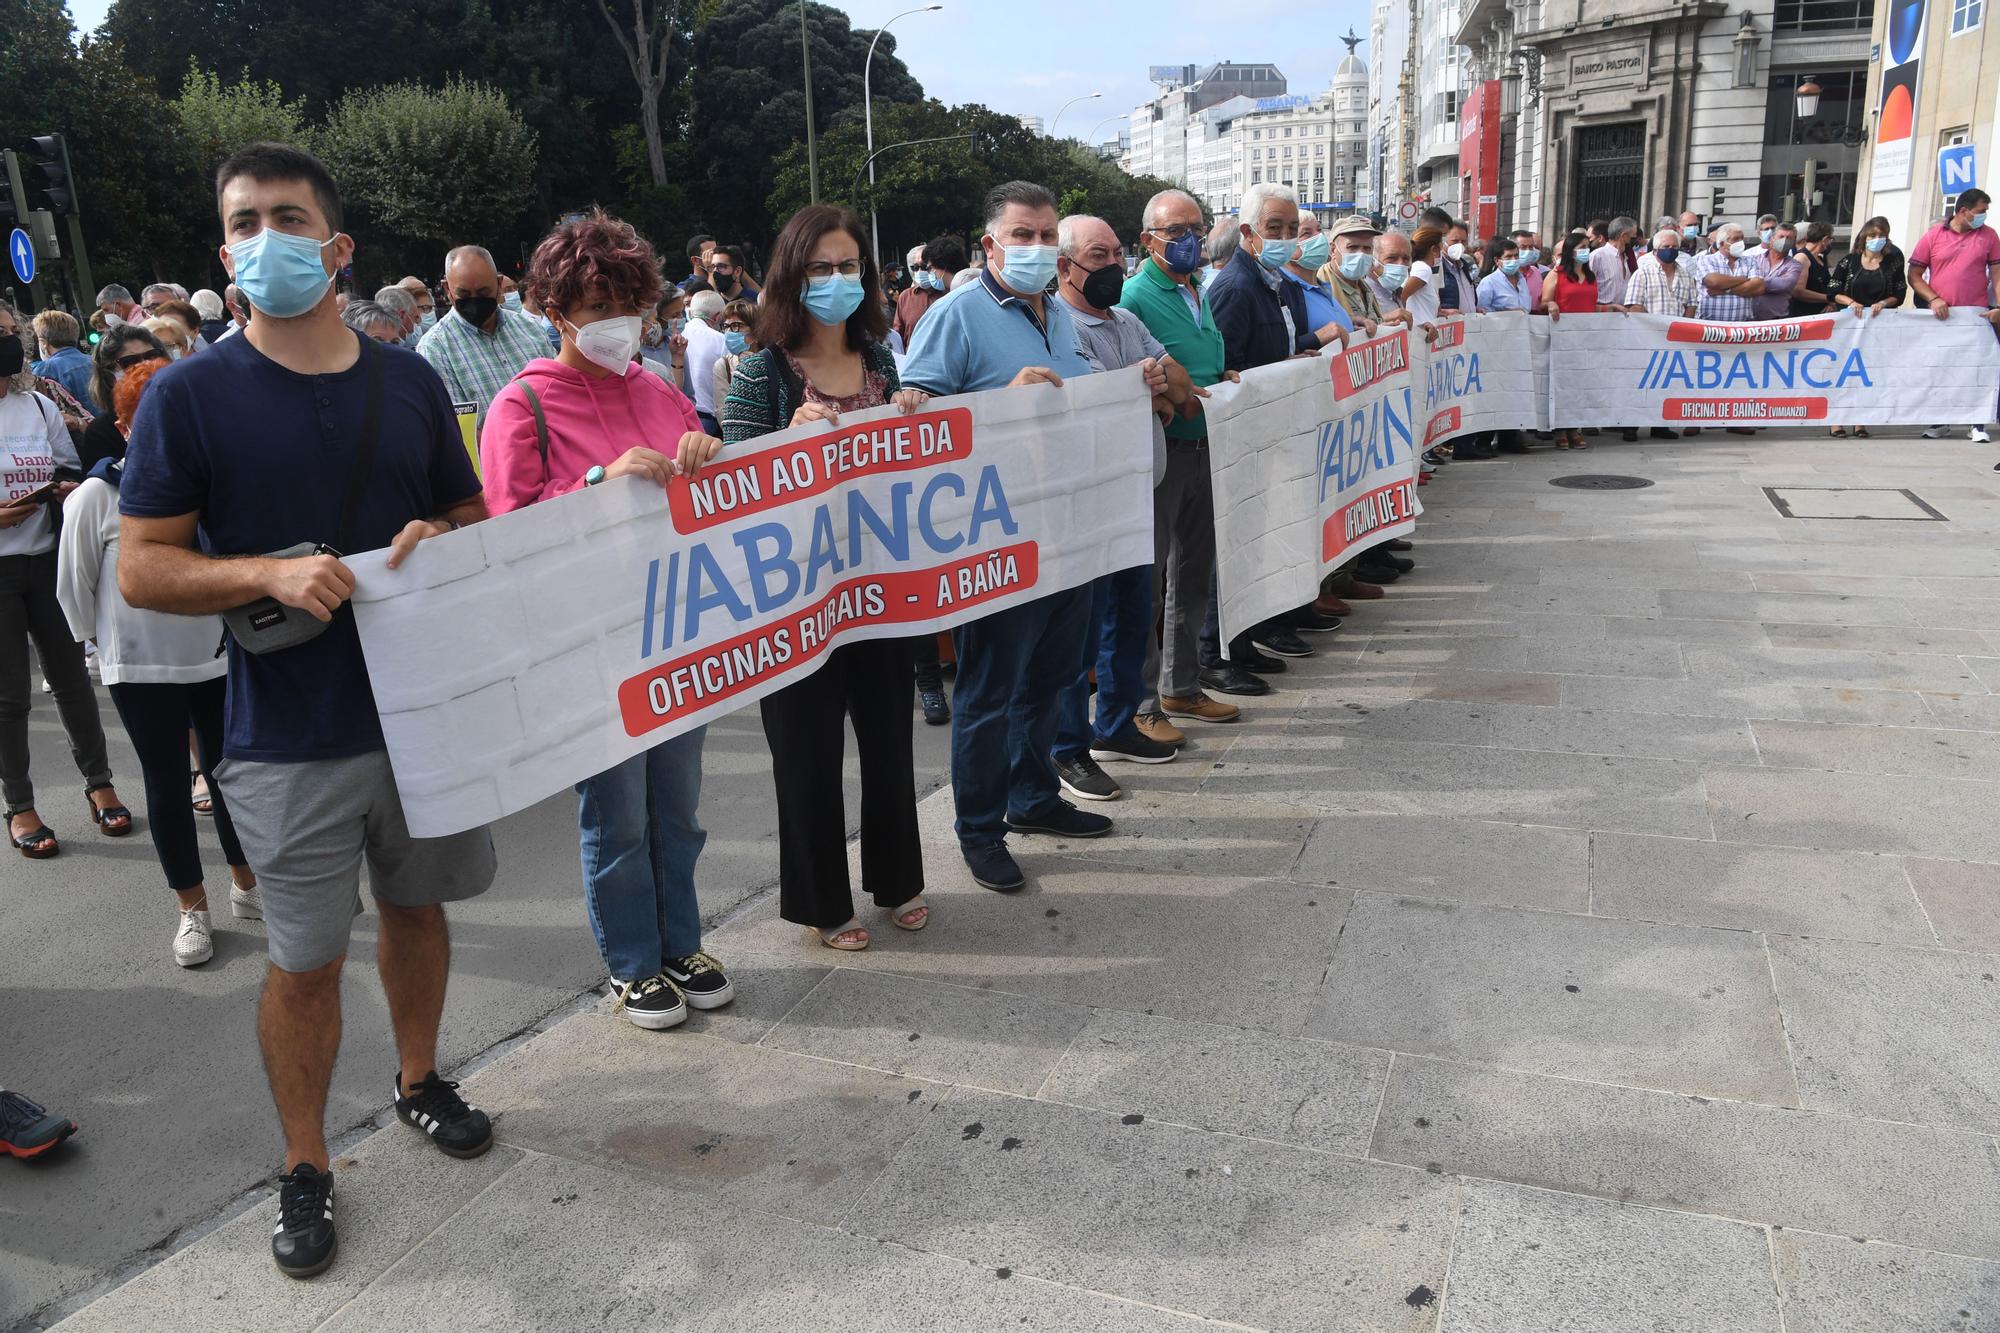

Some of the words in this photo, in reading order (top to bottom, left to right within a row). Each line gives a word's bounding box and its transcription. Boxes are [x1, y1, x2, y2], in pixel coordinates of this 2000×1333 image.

[1575, 63, 1604, 76] BANCO
[1606, 57, 1641, 71] PASTOR
[1945, 155, 1973, 185] N
[1701, 325, 1727, 342] NON
[1729, 326, 1745, 342] AO
[1747, 325, 1783, 342] PECHE
[1785, 324, 1801, 340] DA
[1682, 402, 1716, 417] OFICINA
[1718, 402, 1730, 417] DE
[1733, 399, 1767, 417] BAIÑAS
[3, 468, 54, 488] públic
[689, 464, 762, 519] NON
[771, 450, 815, 497] AO
[822, 426, 913, 481] PECHE
[919, 420, 954, 458] DA
[1345, 496, 1379, 543] OFICINA
[1377, 488, 1399, 525] DE
[647, 628, 791, 717] OFICINAS
[800, 583, 886, 652] RURAIS
[936, 576, 954, 608] A
[959, 551, 1020, 602] BAÑA
